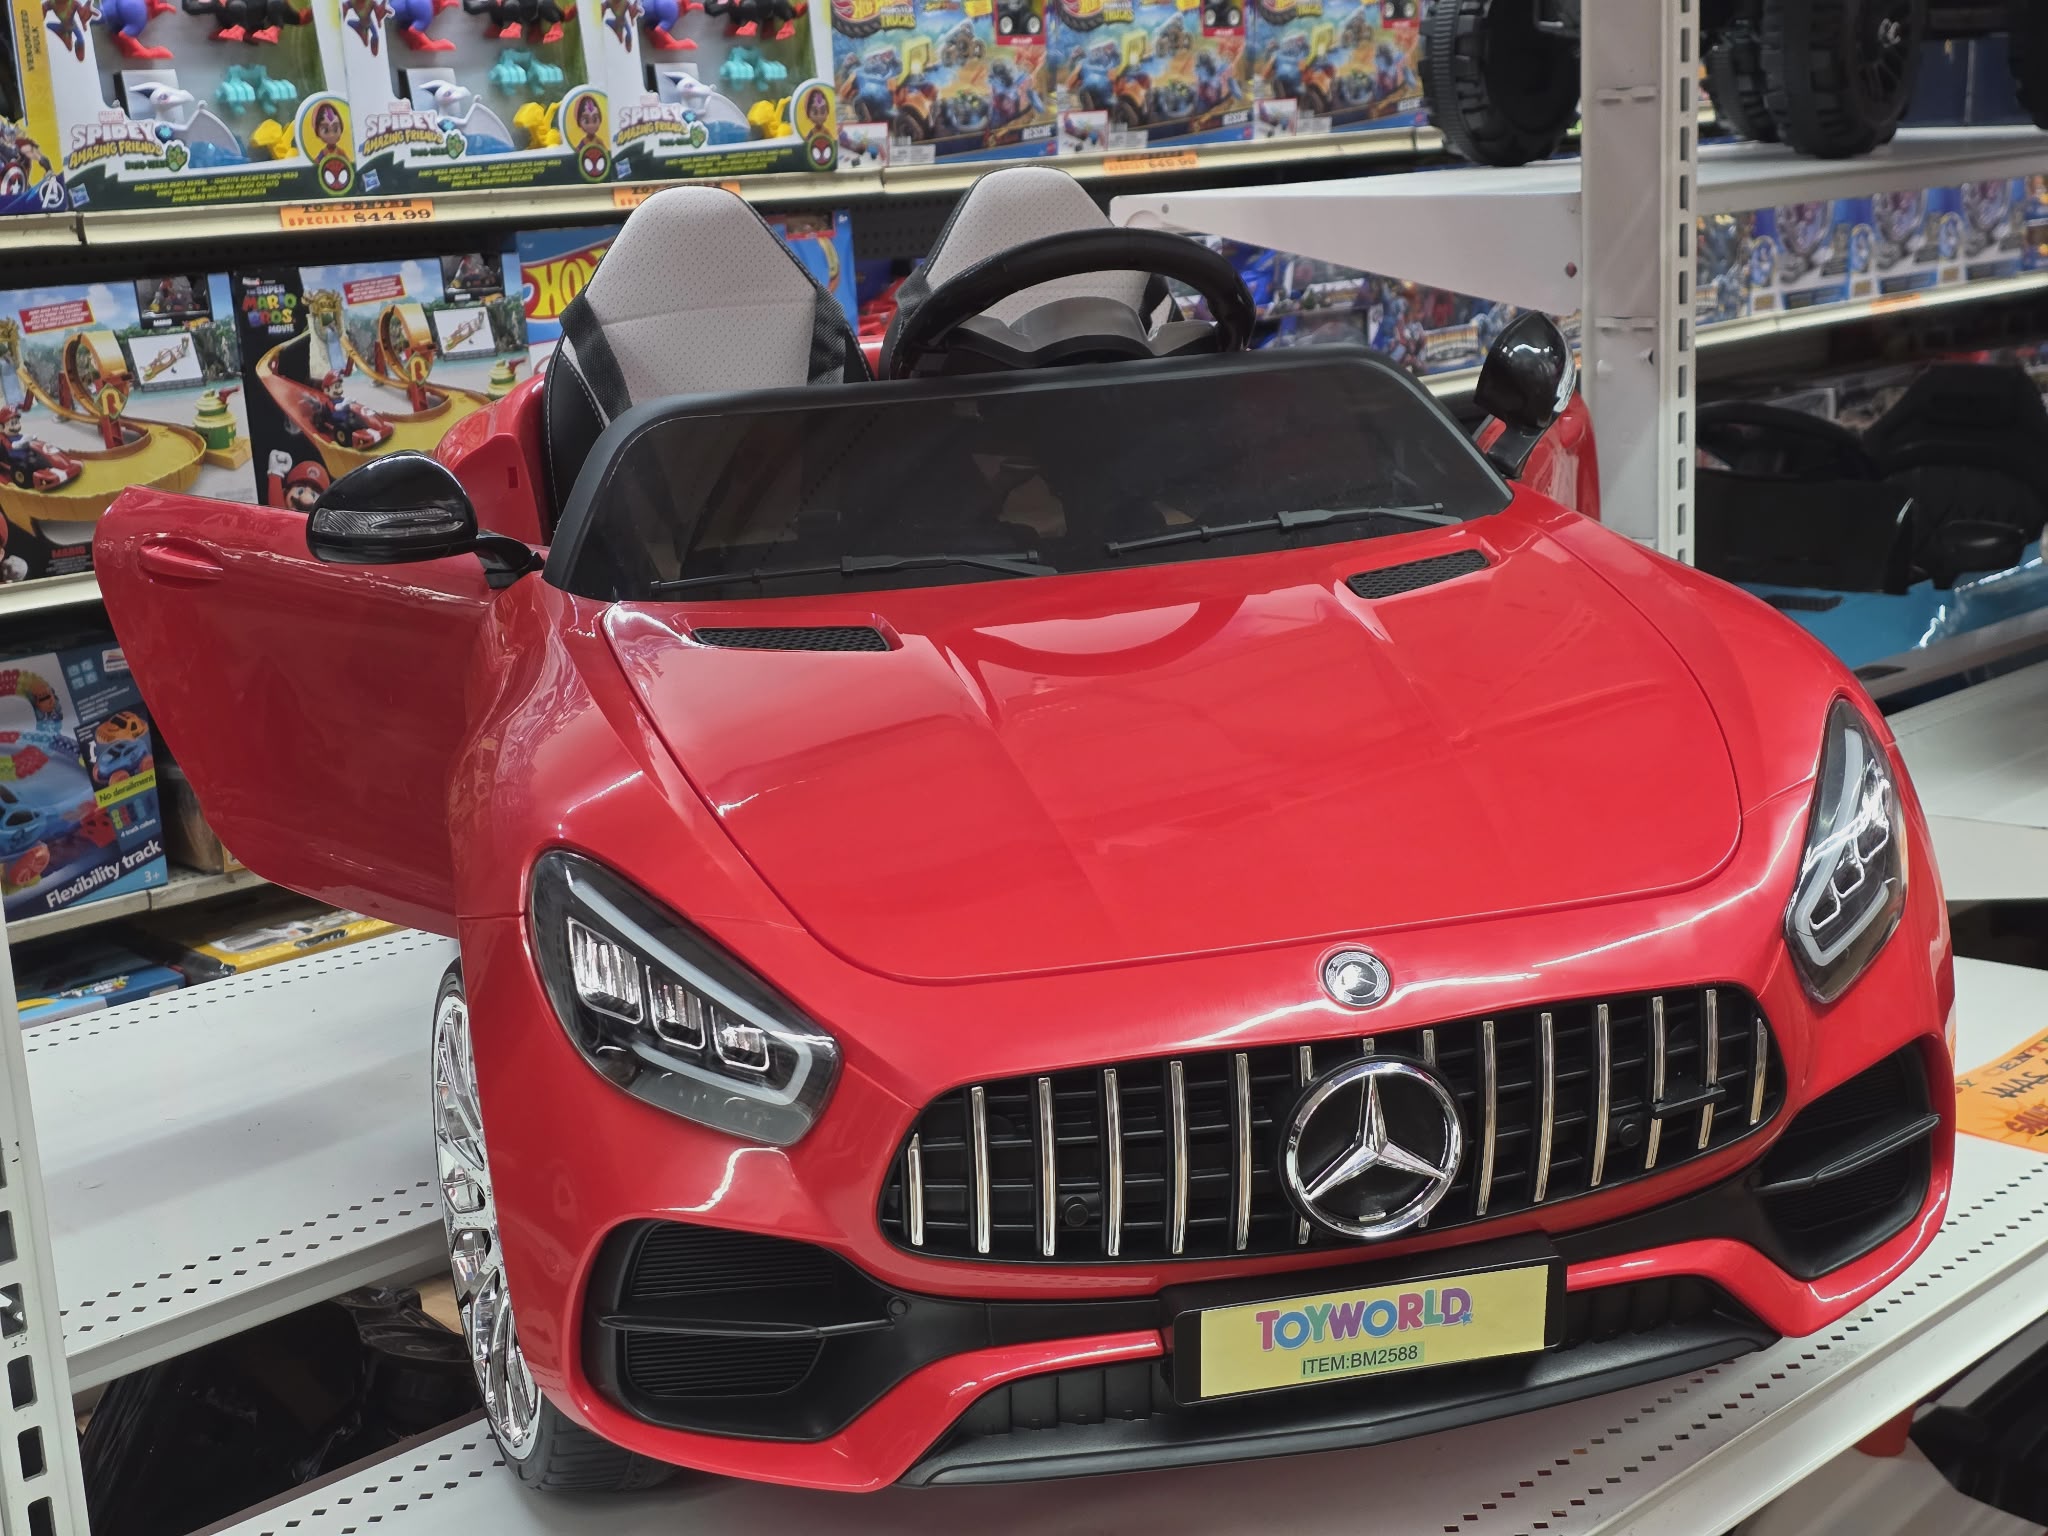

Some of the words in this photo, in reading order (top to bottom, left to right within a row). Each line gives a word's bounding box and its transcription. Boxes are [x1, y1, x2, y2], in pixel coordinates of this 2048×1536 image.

[365, 111, 438, 139] SPIDEY
[618, 103, 684, 129] SPIDEY
[71, 121, 157, 150] SPIDEY
[362, 132, 404, 156] AMAZING
[68, 140, 118, 170] AMAZING
[117, 140, 164, 156] FRIENDS
[288, 214, 349, 227] SPECIAL
[353, 208, 431, 223] $44.99
[242, 292, 297, 312] MARIO
[257, 284, 285, 295] SUPER
[268, 323, 295, 335] MOVIE
[99, 792, 112, 803] No
[113, 775, 155, 797] derailment
[45, 861, 120, 908] Flexibility
[121, 839, 162, 869] track
[144, 870, 160, 883] 3+
[1255, 1286, 1473, 1352] TOYWORLD
[1302, 1344, 1418, 1376] ITEM:BM2588
